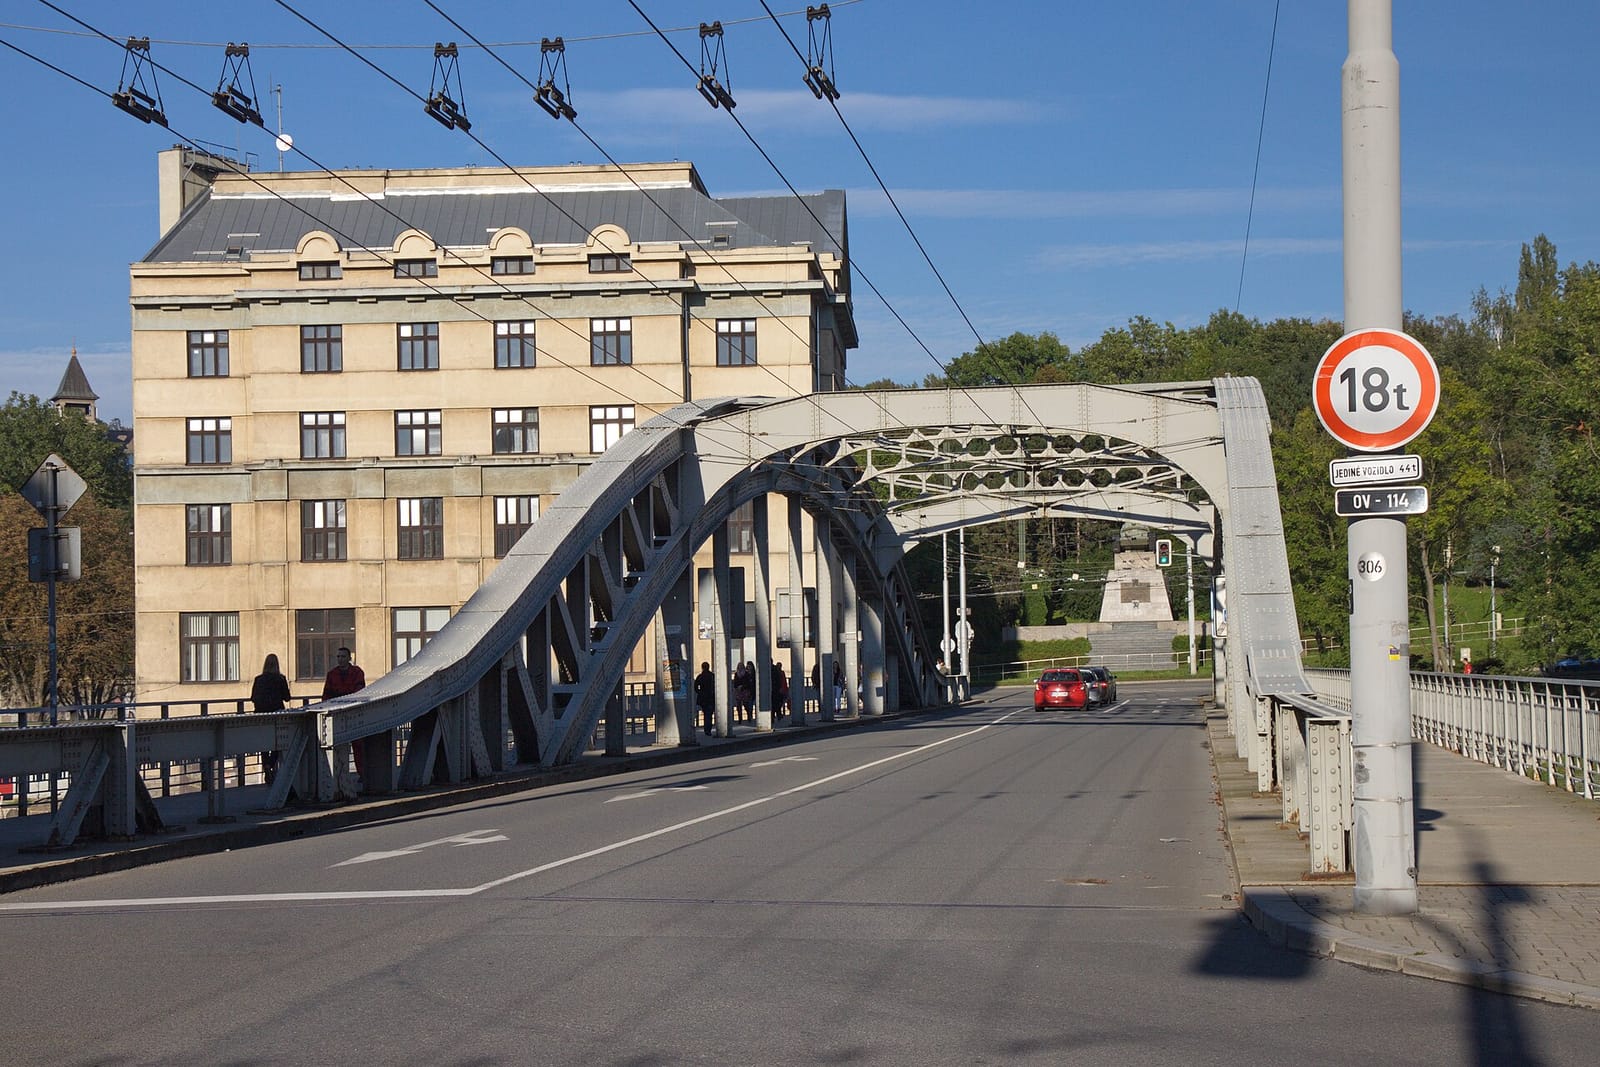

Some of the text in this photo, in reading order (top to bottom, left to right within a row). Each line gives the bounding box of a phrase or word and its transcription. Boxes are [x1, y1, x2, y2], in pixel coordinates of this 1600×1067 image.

[1340, 366, 1410, 412] 18t
[1362, 465, 1395, 476] VOZIDLO
[1358, 560, 1383, 574] 306
